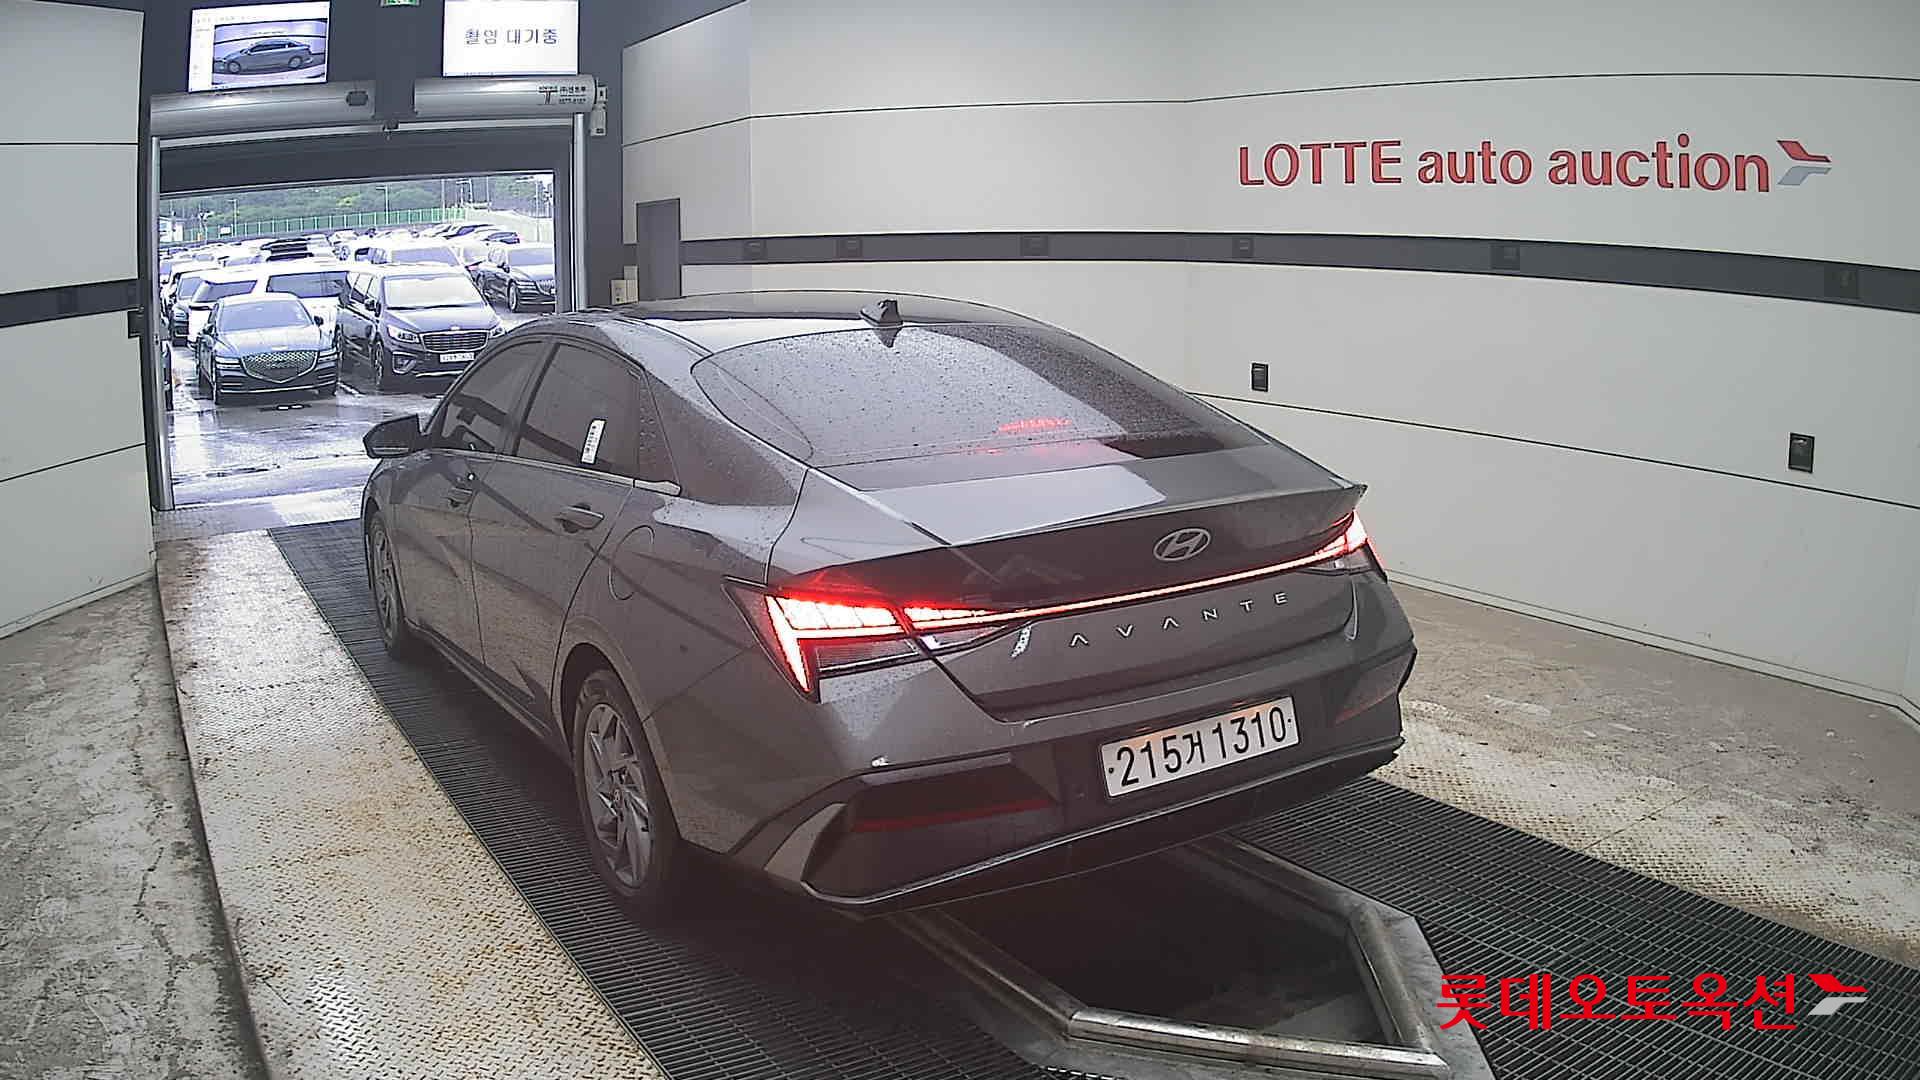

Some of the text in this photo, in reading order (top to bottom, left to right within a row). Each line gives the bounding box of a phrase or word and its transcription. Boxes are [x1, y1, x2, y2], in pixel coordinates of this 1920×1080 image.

[465, 28, 558, 45] 촬영 대기중
[1239, 134, 1770, 191] LOTTE auto auction
[1070, 591, 1289, 647] AVANTE
